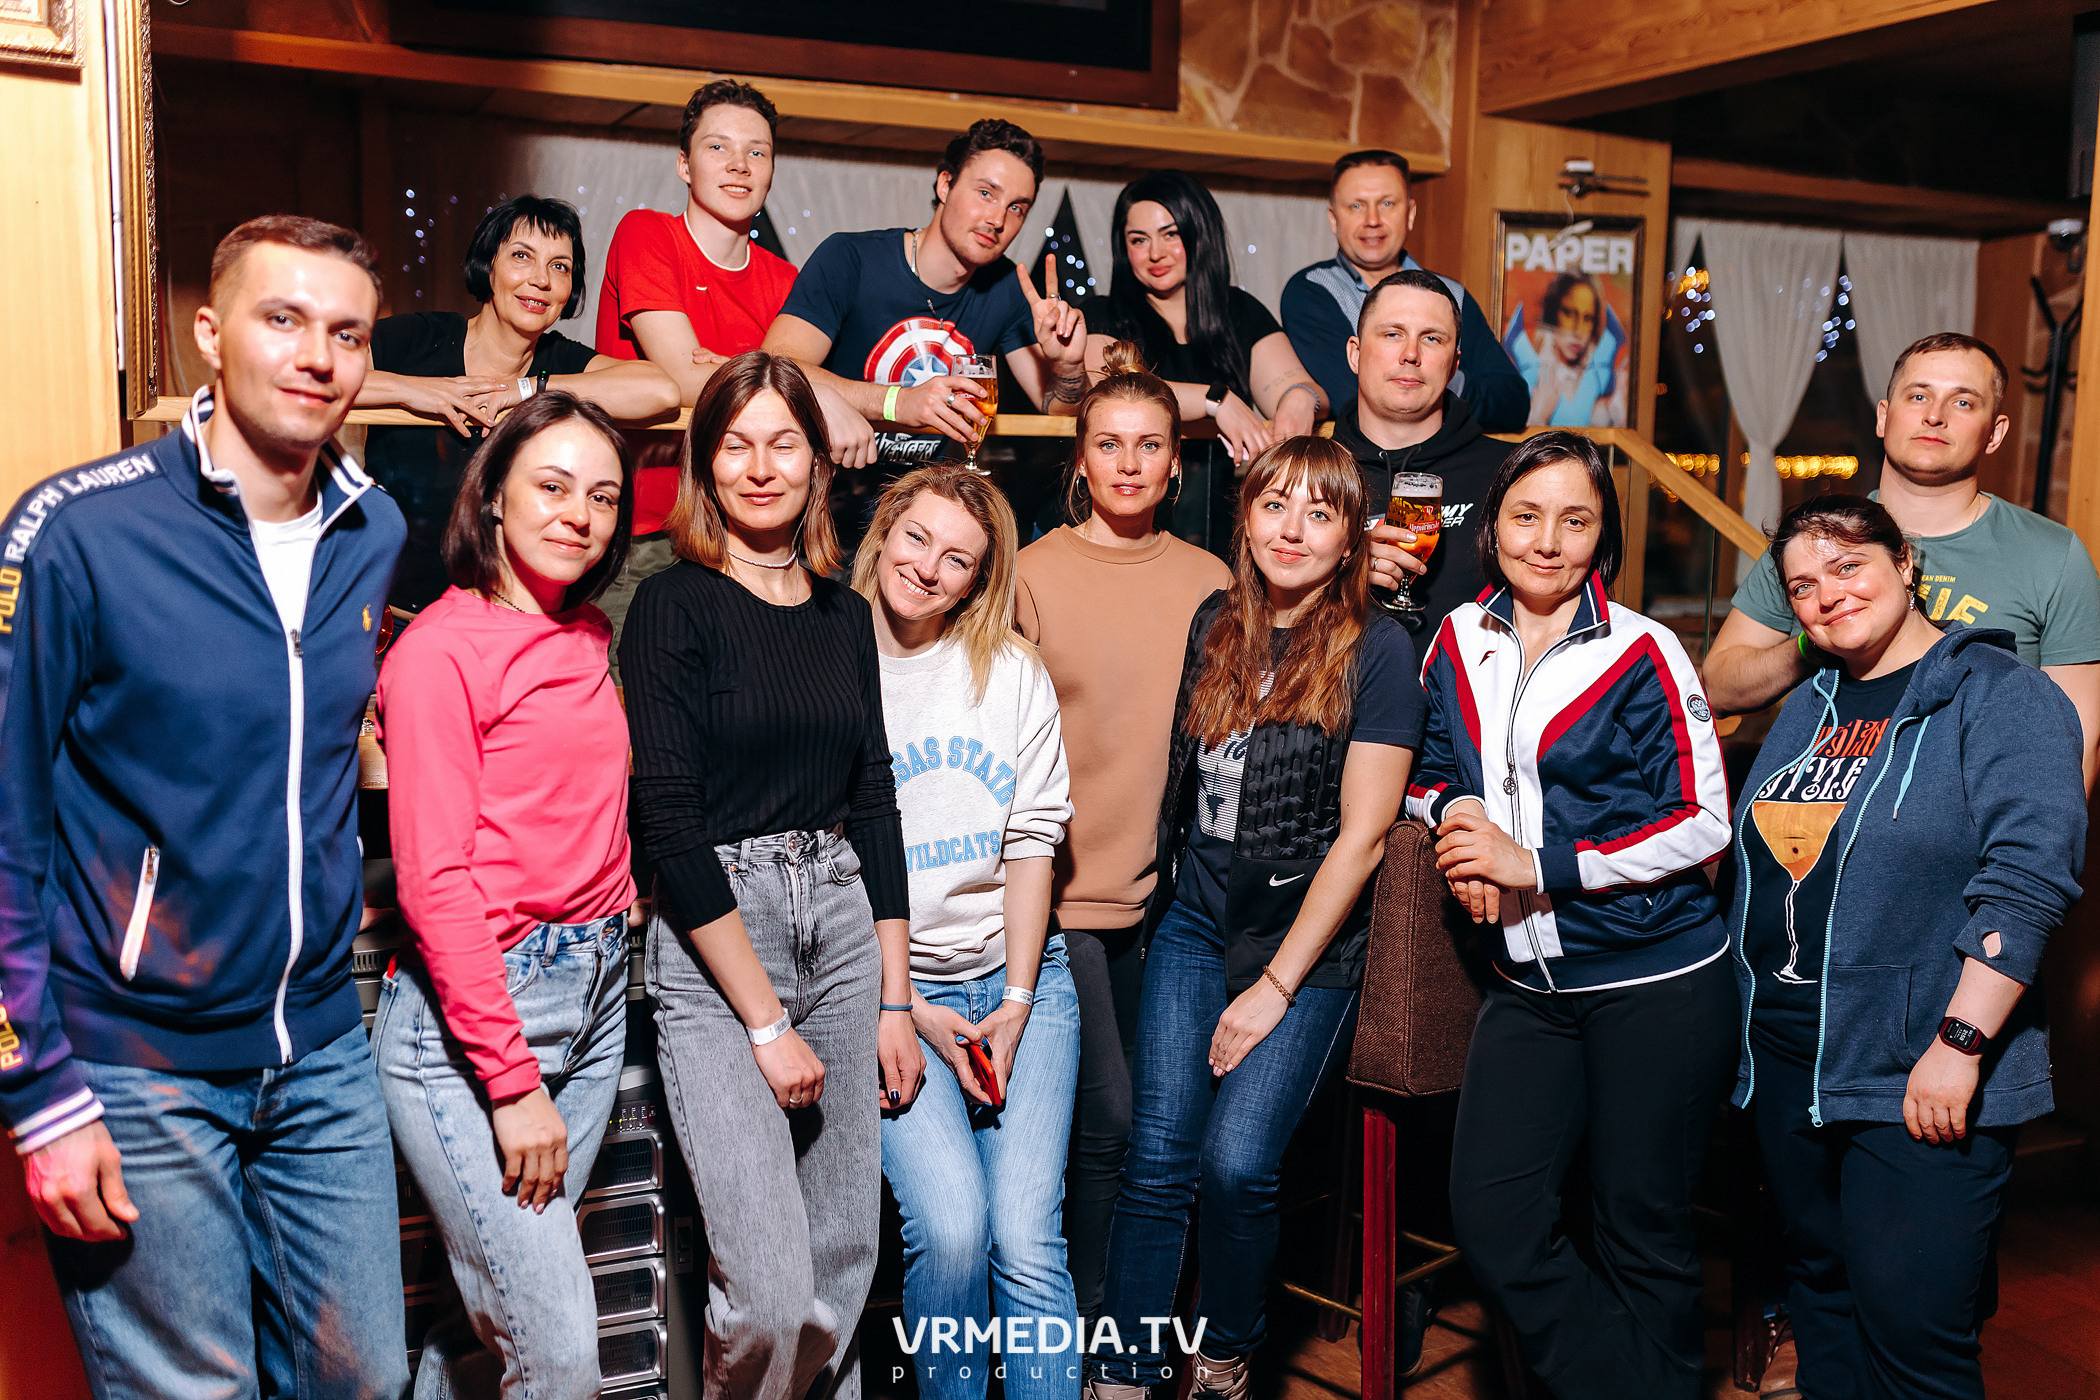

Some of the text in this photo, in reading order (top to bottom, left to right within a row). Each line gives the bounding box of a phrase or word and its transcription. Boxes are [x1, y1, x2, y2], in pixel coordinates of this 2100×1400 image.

[1506, 232, 1635, 274] PAPER
[4, 484, 64, 564] RALPH
[58, 453, 156, 496] LAUREN
[1441, 502, 1474, 519] MY
[1934, 575, 1956, 583] DENIM
[890, 735, 1016, 807] SAS STATE
